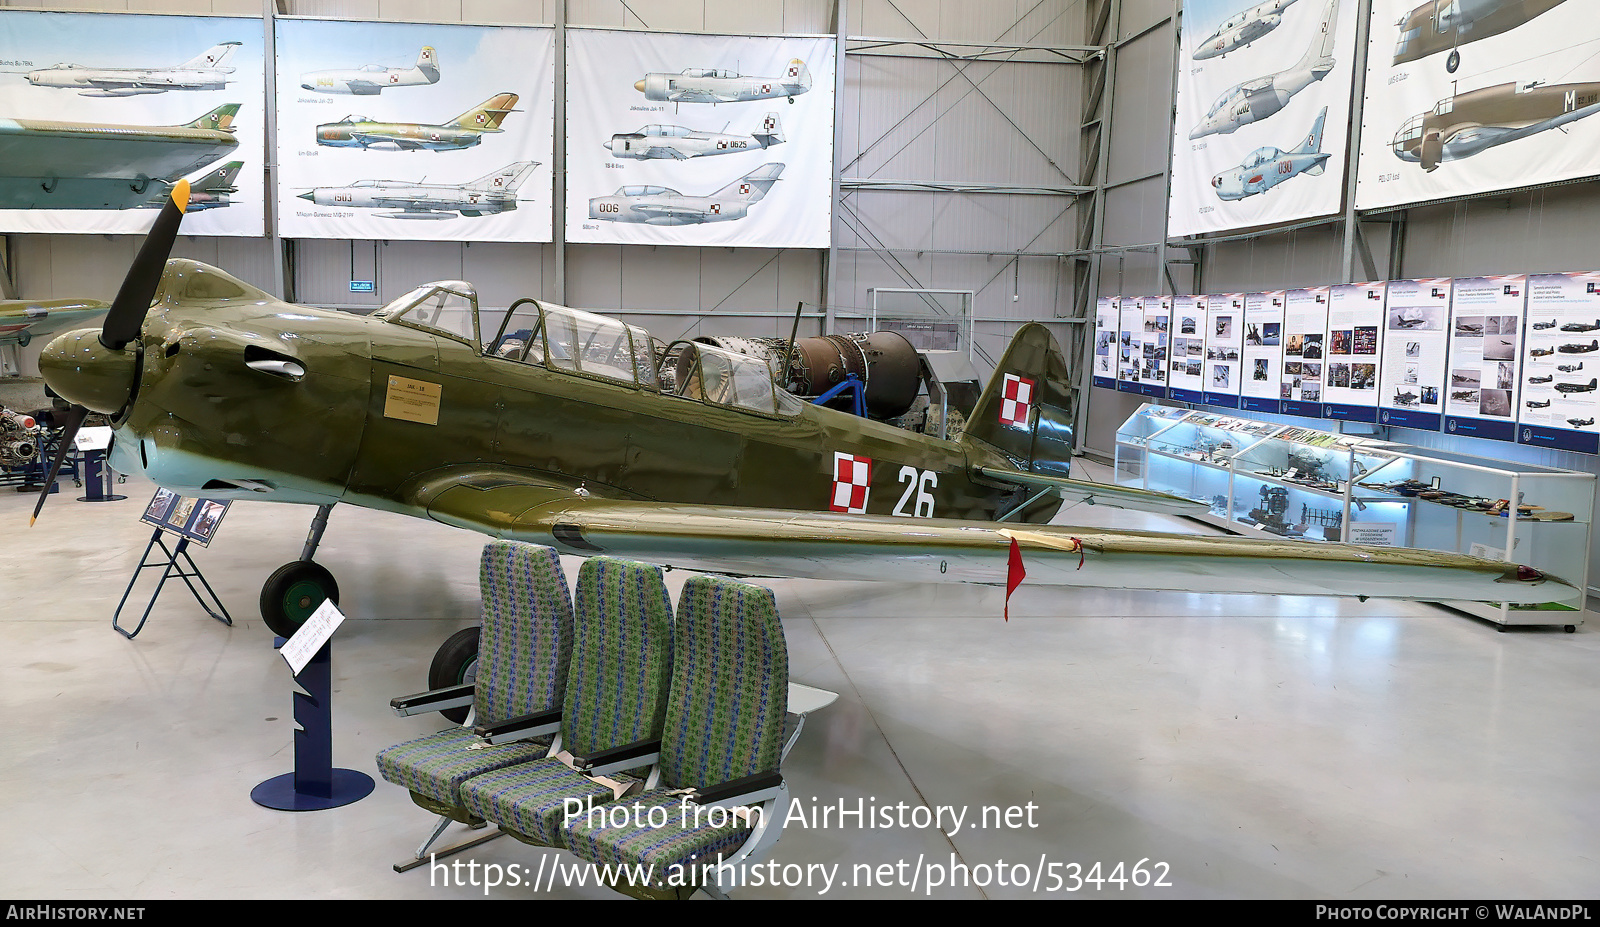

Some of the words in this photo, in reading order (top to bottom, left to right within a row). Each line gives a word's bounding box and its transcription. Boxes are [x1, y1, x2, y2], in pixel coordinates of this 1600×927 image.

[1564, 89, 1576, 112] M
[730, 140, 747, 149] 0625
[1278, 160, 1293, 174] 030
[599, 203, 619, 213] 006
[892, 465, 938, 518] 26
